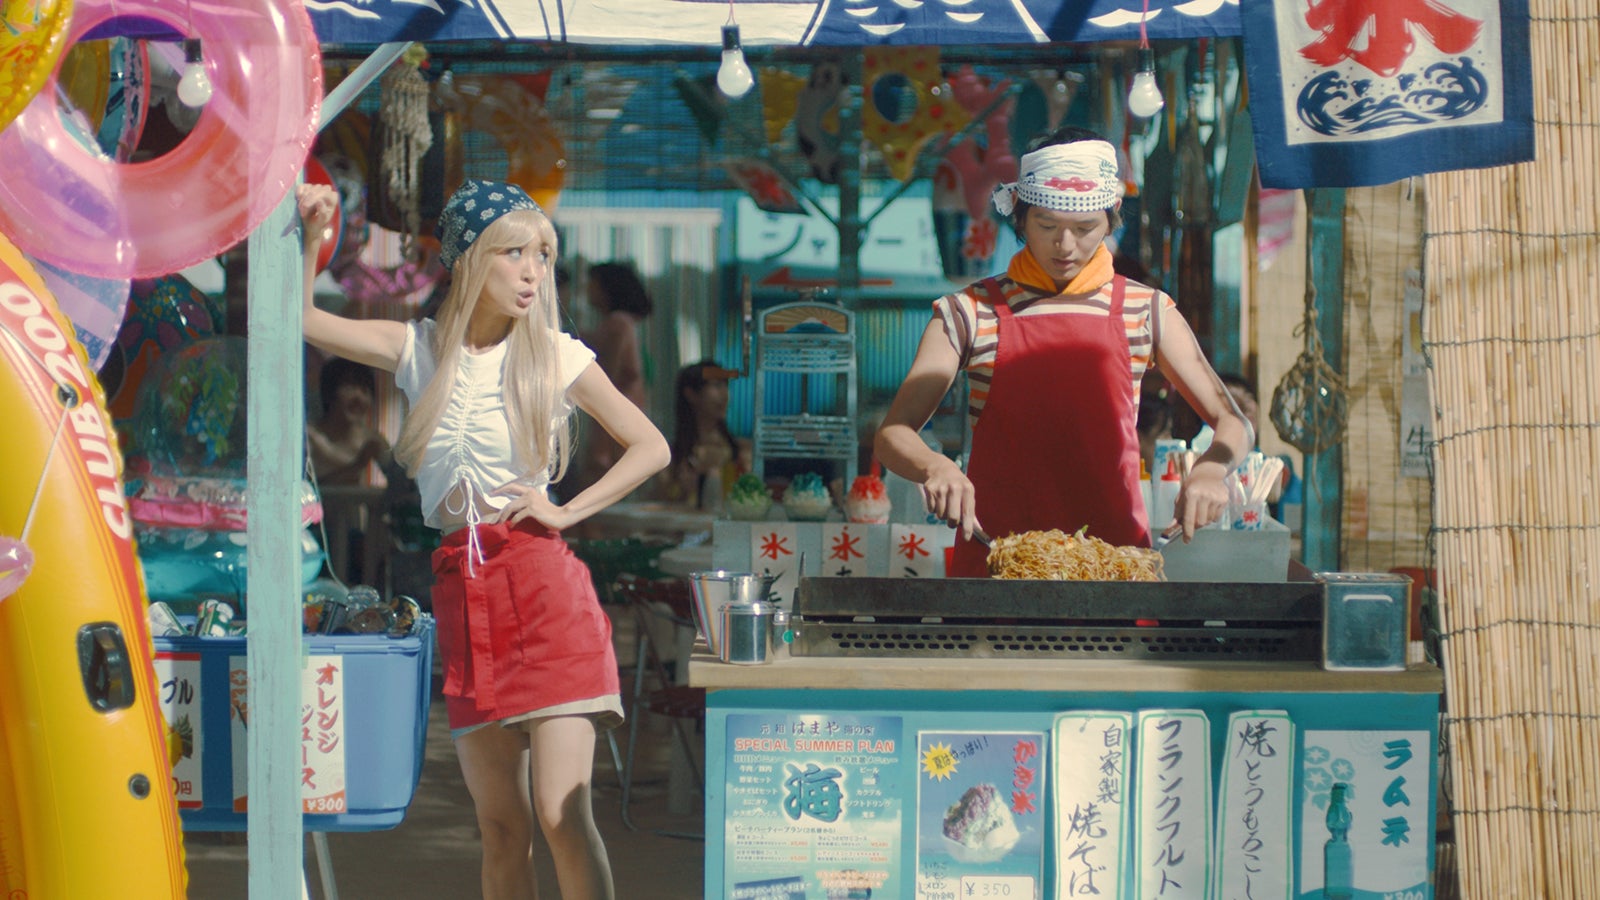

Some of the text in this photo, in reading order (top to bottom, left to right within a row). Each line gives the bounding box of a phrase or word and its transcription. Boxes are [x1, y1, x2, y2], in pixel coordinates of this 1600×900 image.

[0, 282, 131, 540] CLUB 200
[760, 532, 793, 561] 氷
[829, 526, 864, 562] 氷
[899, 532, 930, 561] 氷
[315, 662, 340, 754] オレンジ
[791, 720, 840, 736] はまや
[735, 739, 895, 753] SPECIAL SUMMER PLAN
[1097, 724, 1122, 804] 自家製
[783, 763, 844, 822] 海
[1012, 739, 1038, 815] かき氷
[307, 797, 344, 811] ¥300
[1152, 719, 1185, 895] フランクフルト
[1235, 719, 1277, 900] 焼とうもろこし
[1066, 802, 1107, 897] 焼そば
[925, 882, 948, 890] メロン
[983, 883, 1011, 896] 350
